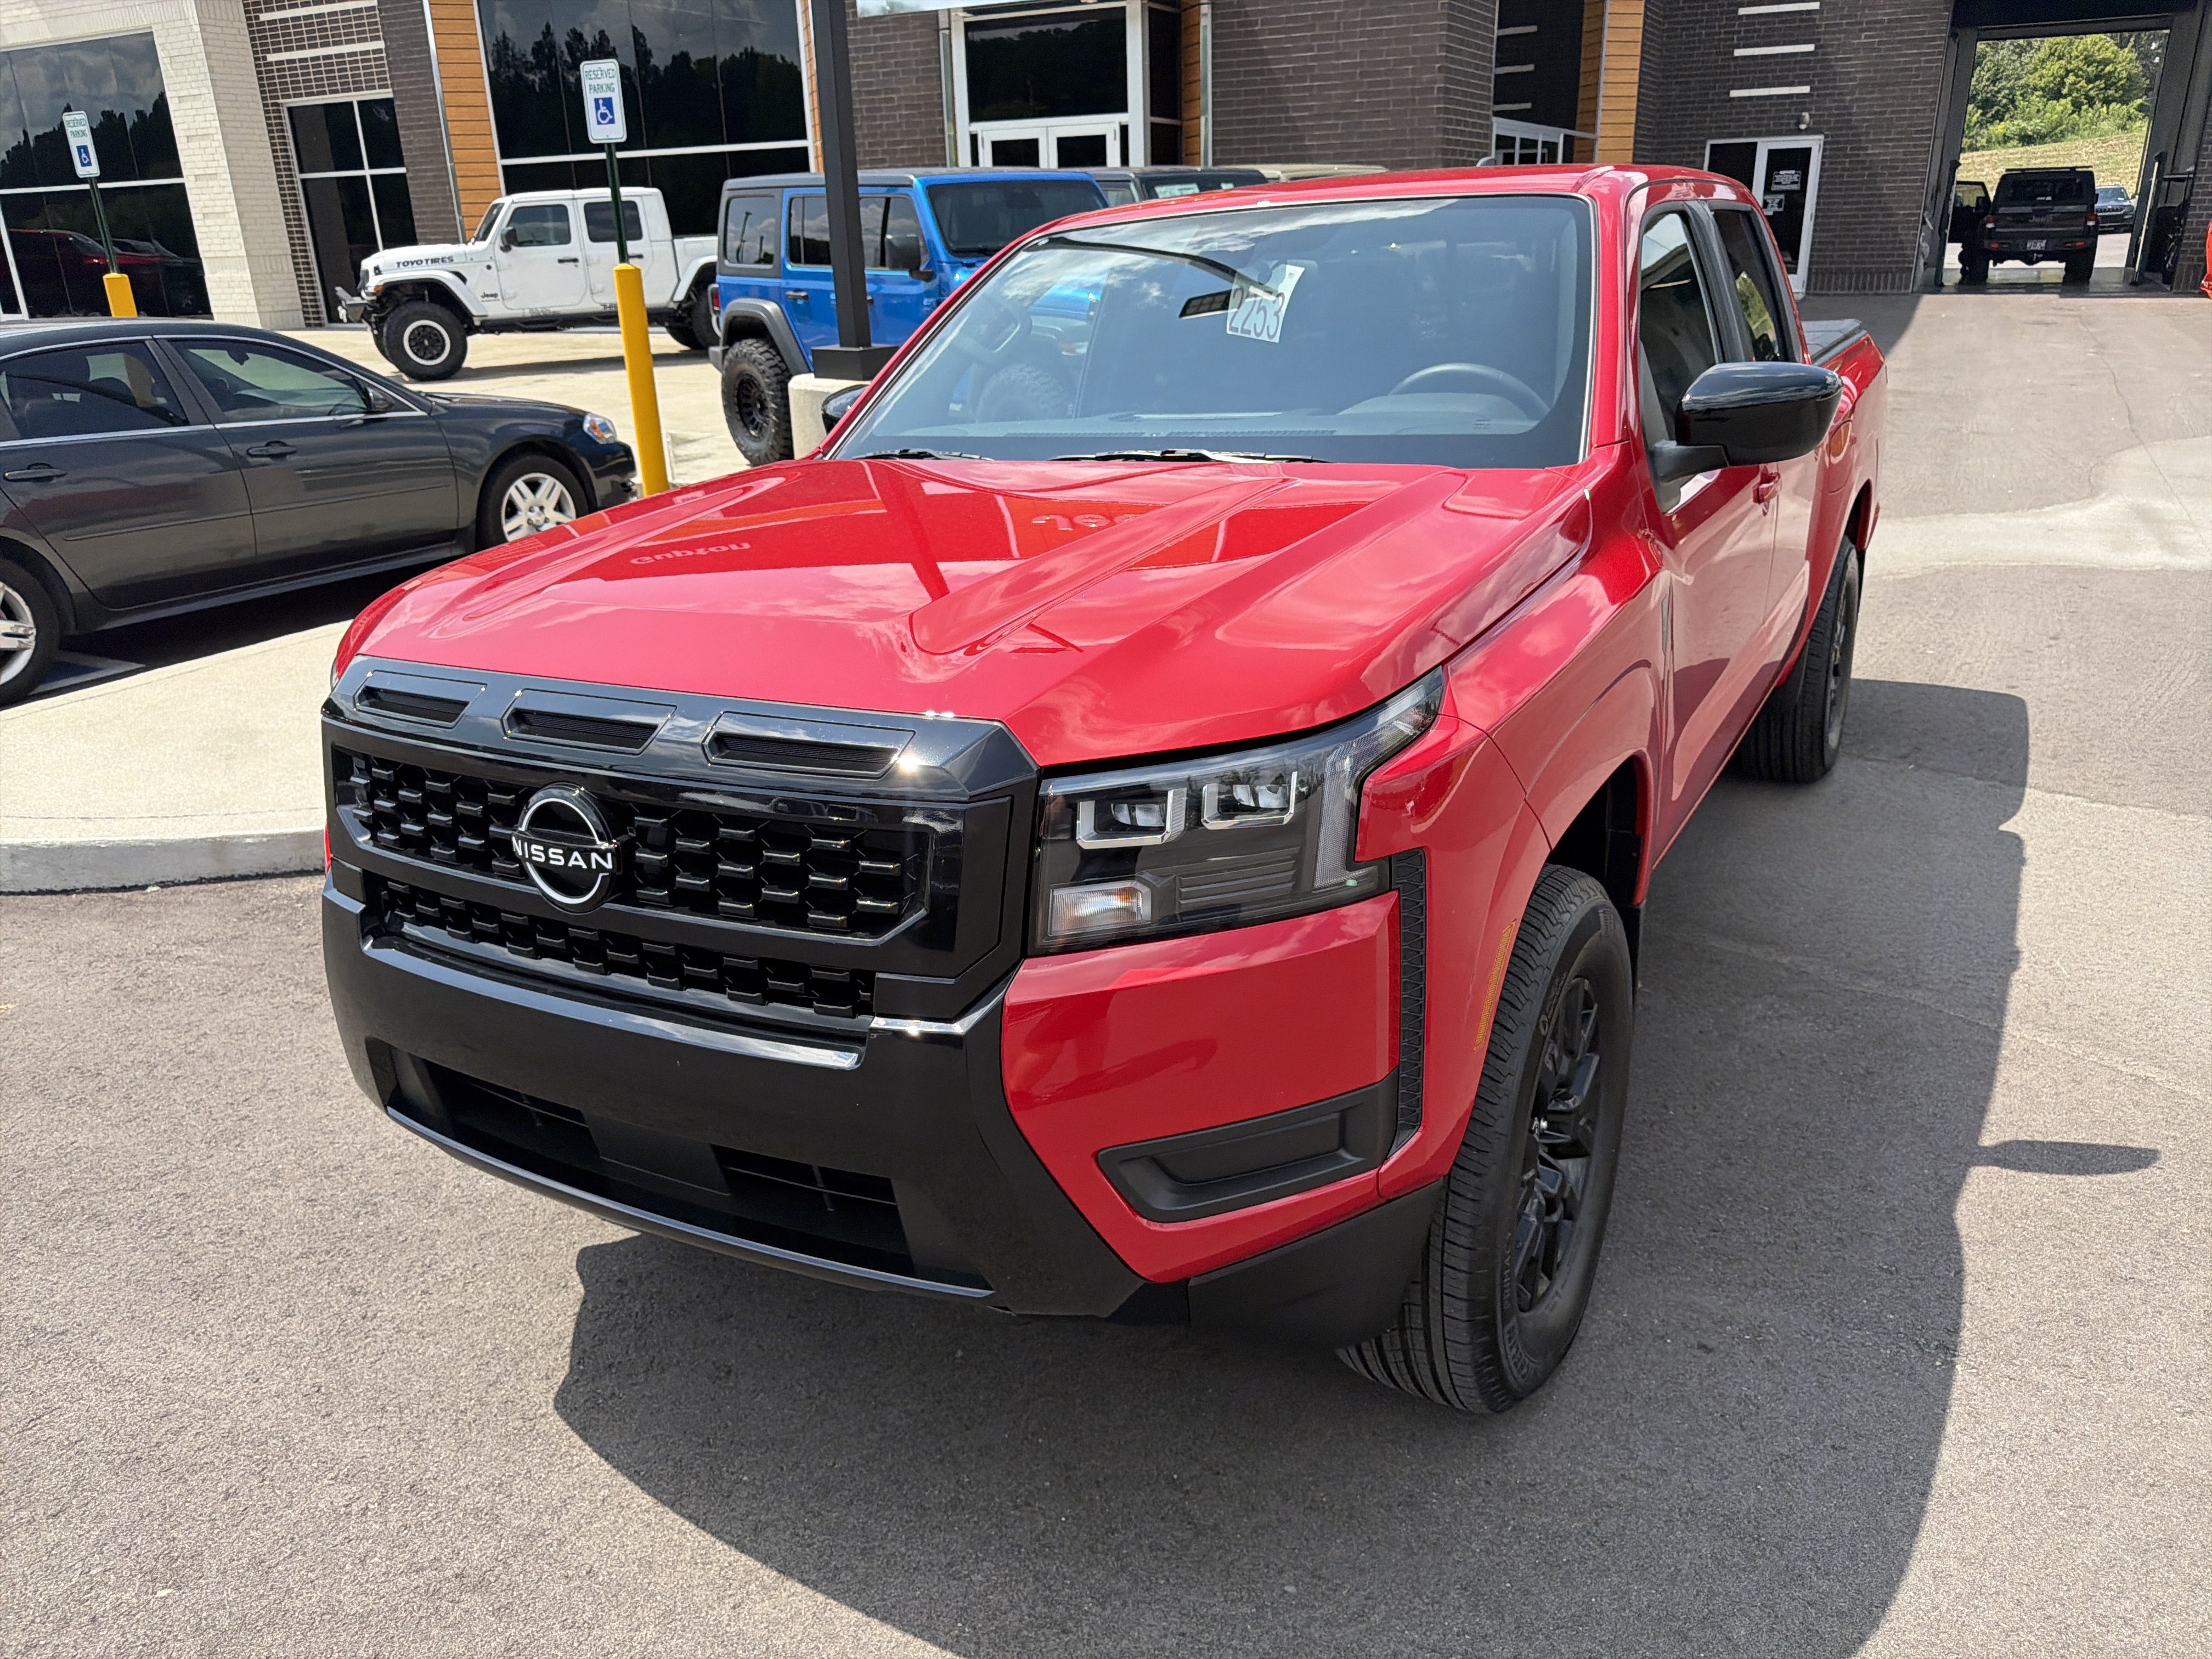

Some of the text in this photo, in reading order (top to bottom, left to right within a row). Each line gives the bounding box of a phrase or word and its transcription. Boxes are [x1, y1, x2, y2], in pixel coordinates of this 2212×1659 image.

[585, 68, 617, 80] RESERVED
[589, 82, 615, 94] PARKING
[396, 255, 454, 268] TOYO TIRES
[1229, 286, 1285, 340] 2253
[512, 836, 613, 869] NISSAN
